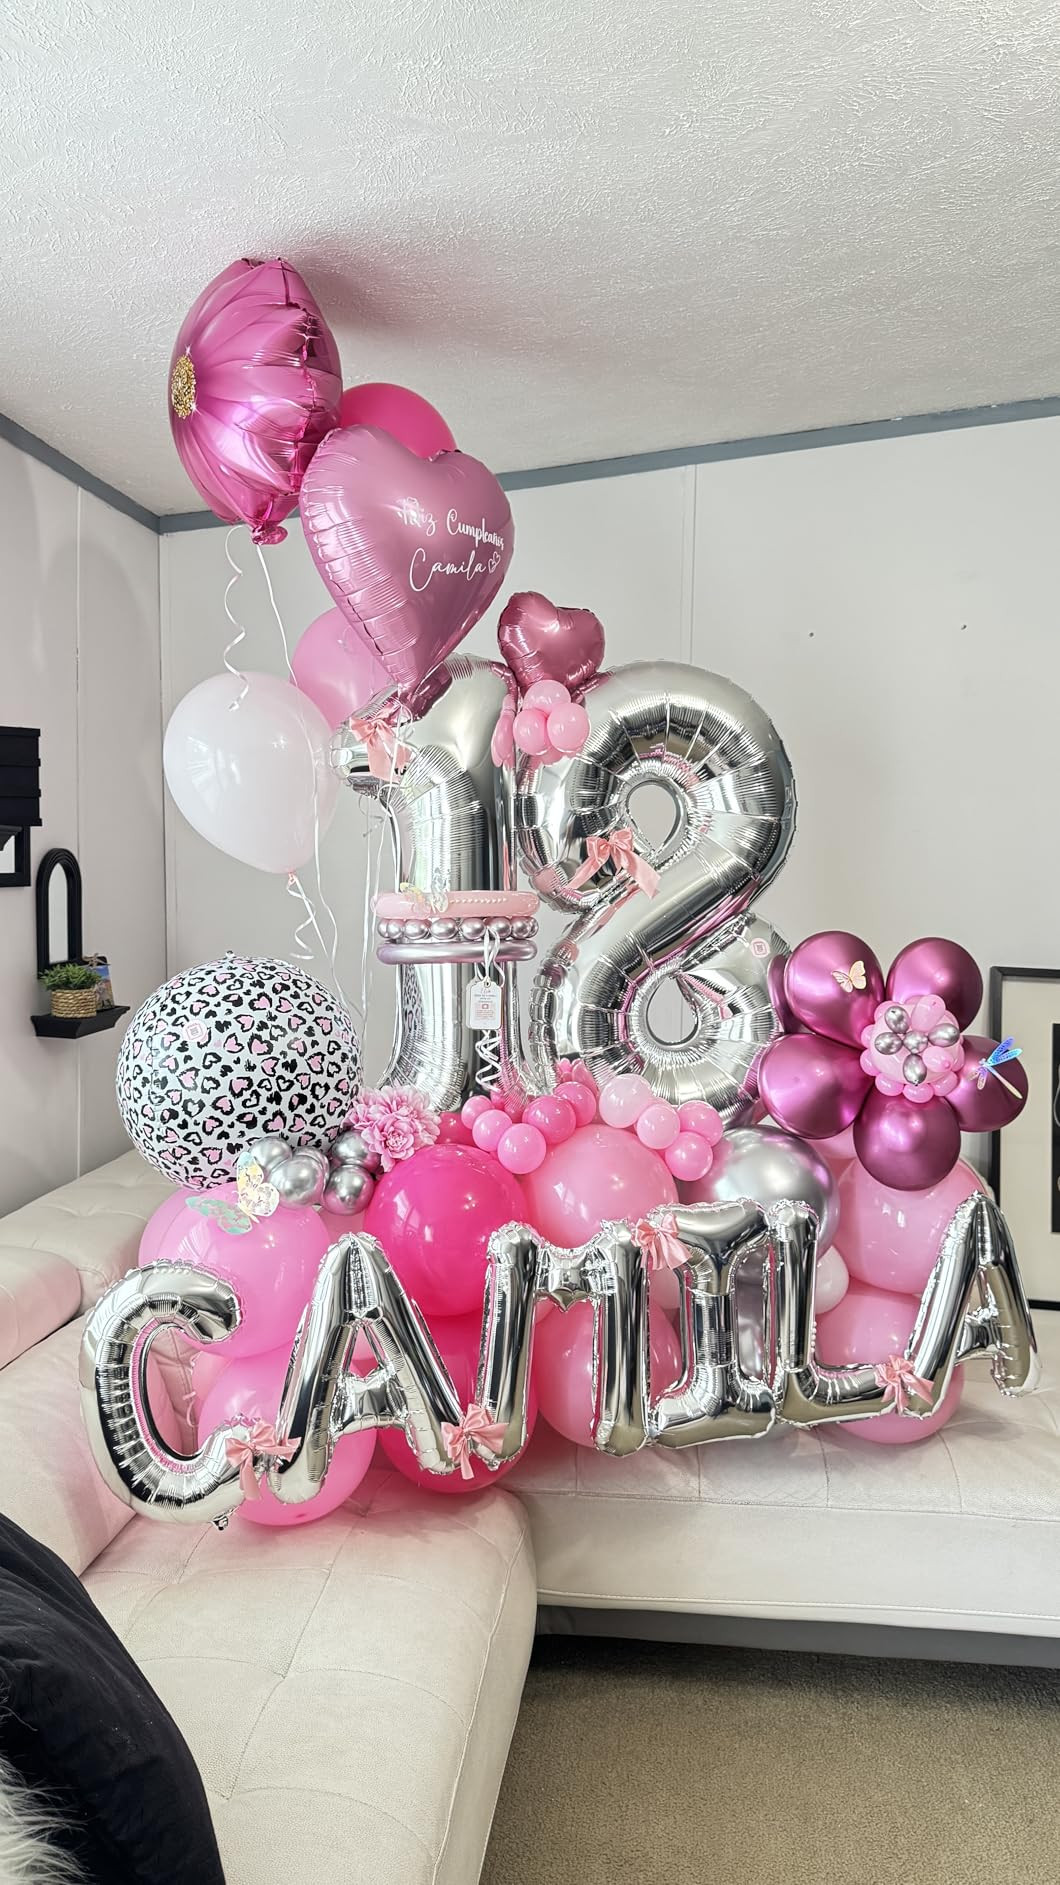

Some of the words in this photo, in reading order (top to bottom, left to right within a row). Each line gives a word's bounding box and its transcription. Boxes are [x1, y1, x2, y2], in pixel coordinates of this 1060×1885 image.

[397, 496, 437, 537] Fiz
[409, 547, 486, 592] Camila
[329, 654, 797, 1122] 18
[78, 1190, 1041, 1526] CAMILA
